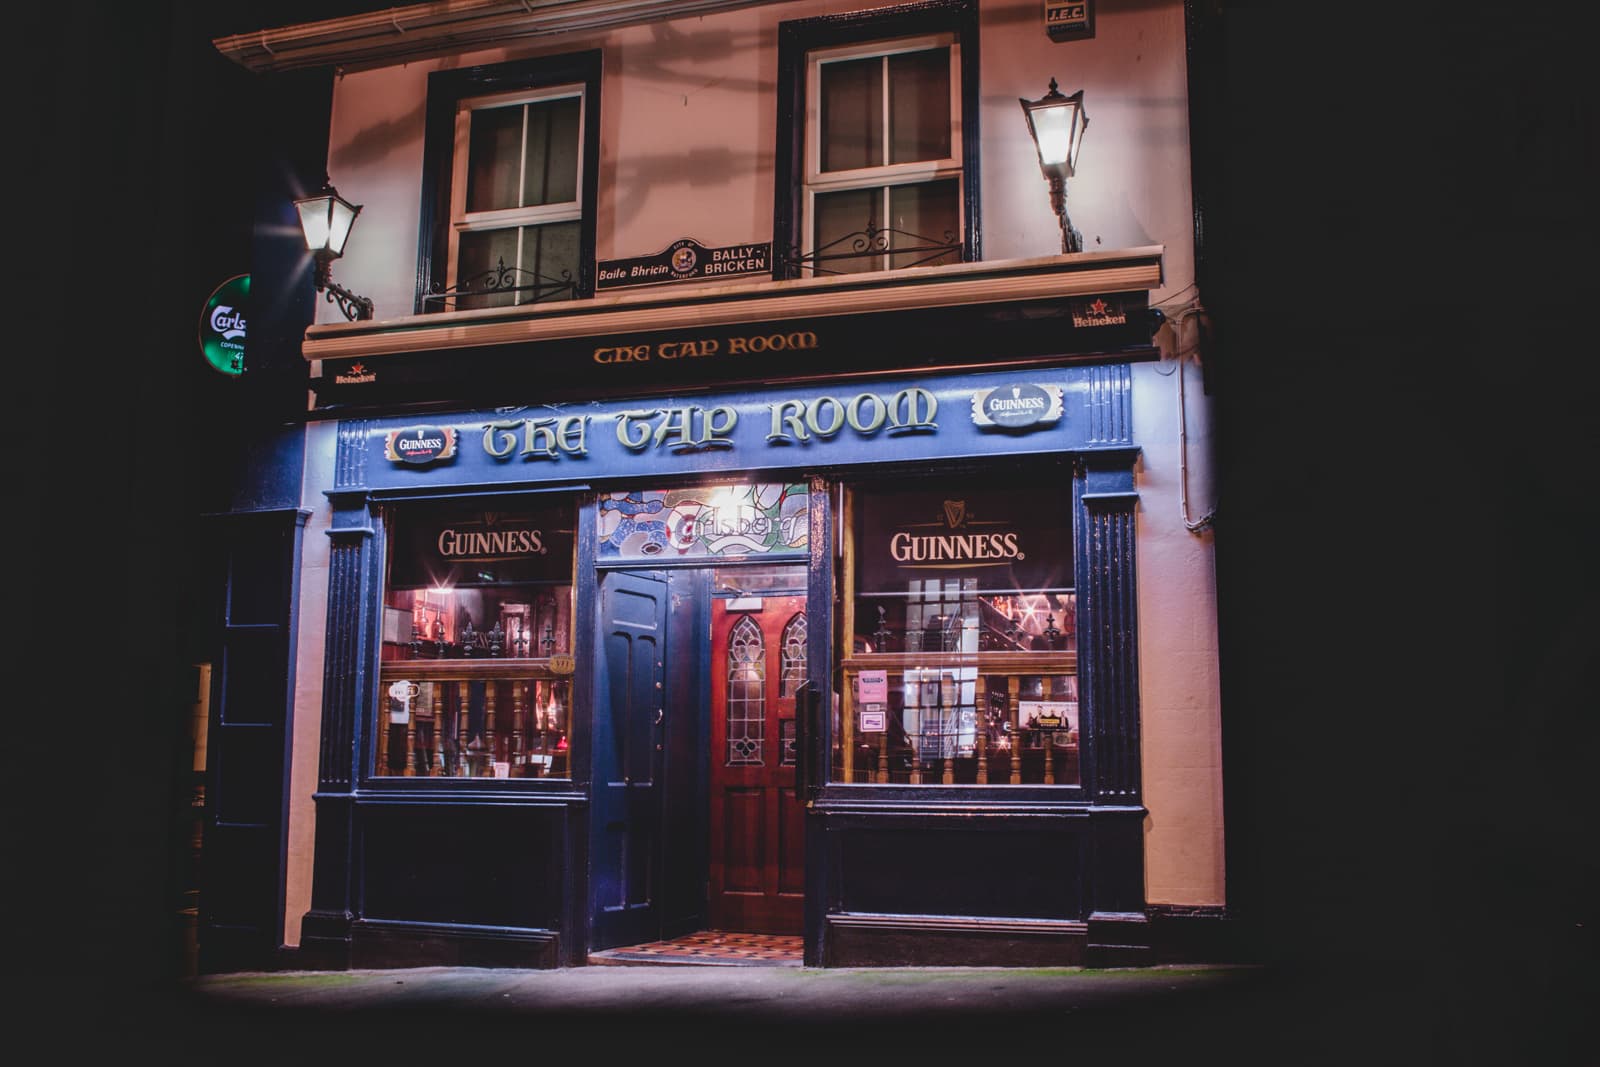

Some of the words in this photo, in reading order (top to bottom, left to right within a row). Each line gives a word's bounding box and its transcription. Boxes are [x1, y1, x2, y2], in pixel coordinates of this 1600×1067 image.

[599, 267, 627, 281] Baile
[705, 259, 765, 275] BRICKEN
[1073, 315, 1126, 328] Heineken
[593, 345, 650, 364] THE
[658, 339, 719, 359] TAP
[728, 331, 819, 354] ROOM
[990, 397, 1044, 411] GUINNESS
[482, 415, 592, 459] THE
[616, 405, 738, 449] TAP
[766, 387, 939, 442] ROOM
[400, 438, 441, 450] GUINNESS
[438, 529, 542, 556] GUINNESS
[890, 532, 1019, 562] GUINNESS
